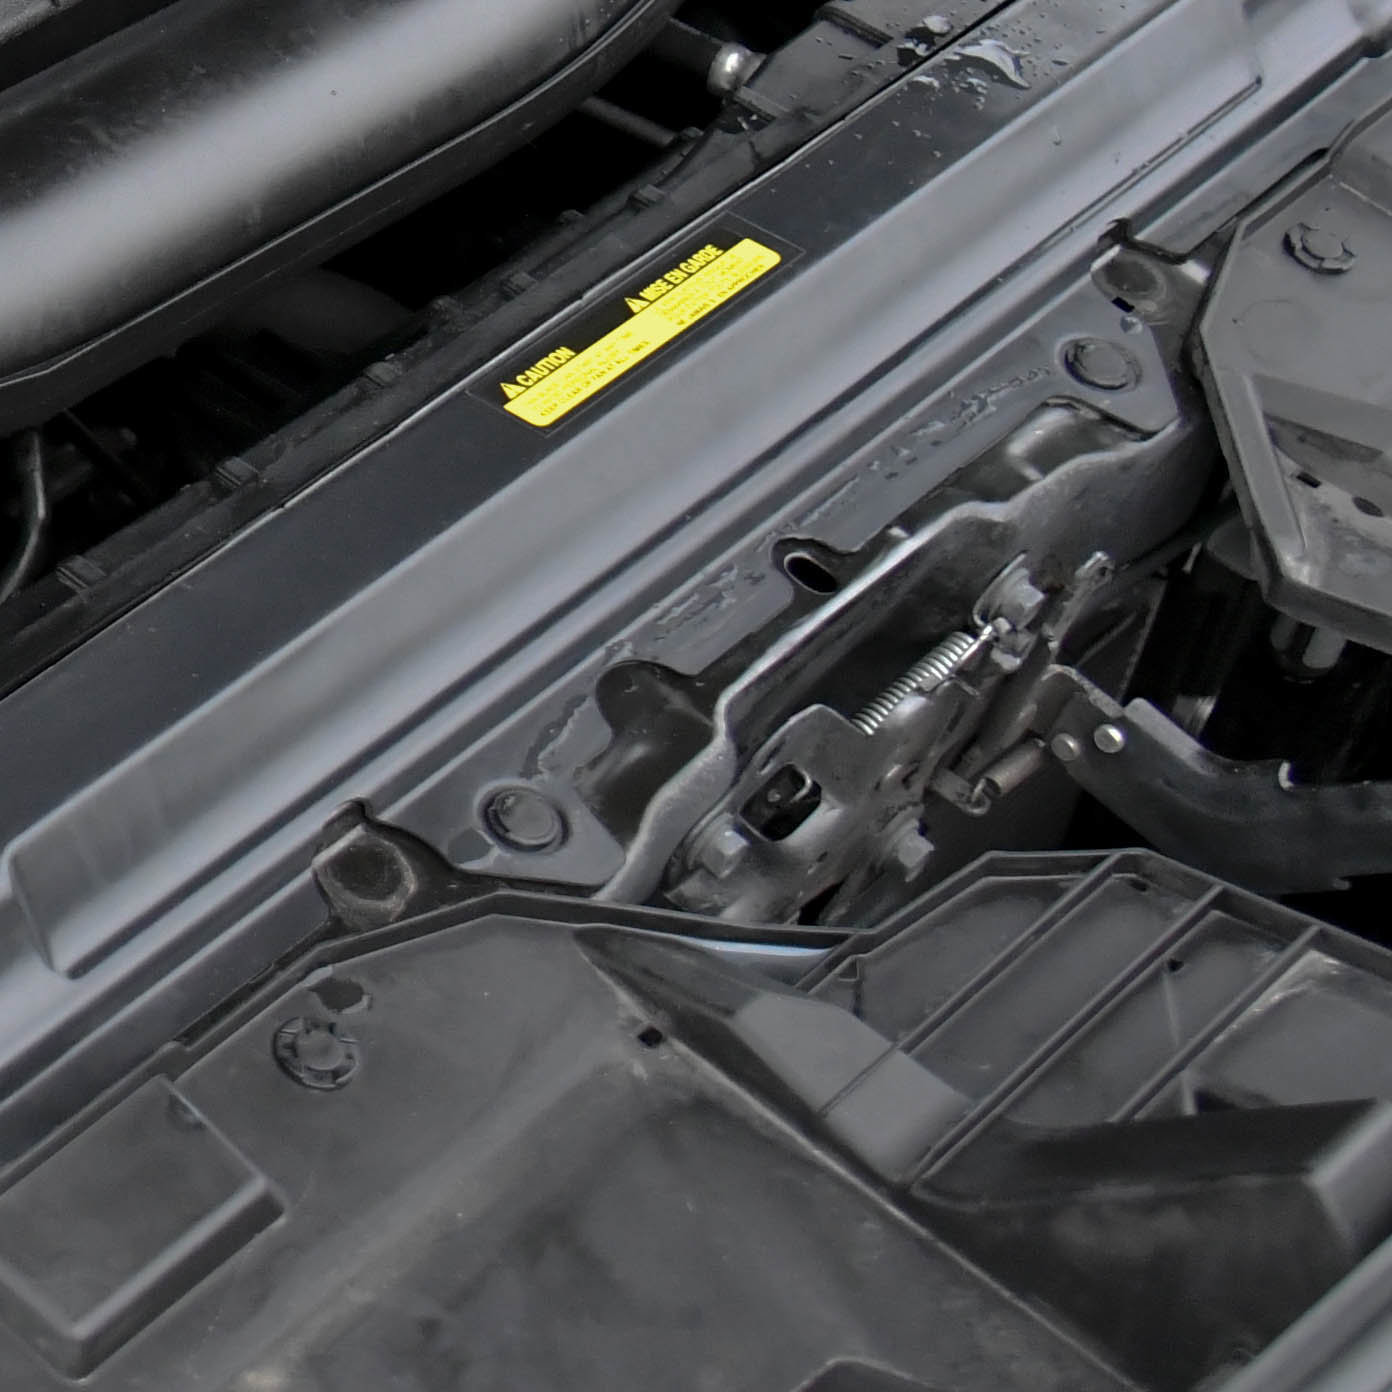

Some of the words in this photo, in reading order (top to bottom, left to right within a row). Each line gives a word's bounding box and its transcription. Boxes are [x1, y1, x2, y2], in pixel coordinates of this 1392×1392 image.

[638, 279, 673, 303] MISE
[682, 243, 724, 275] GARDE
[515, 345, 578, 388] CAUTION
